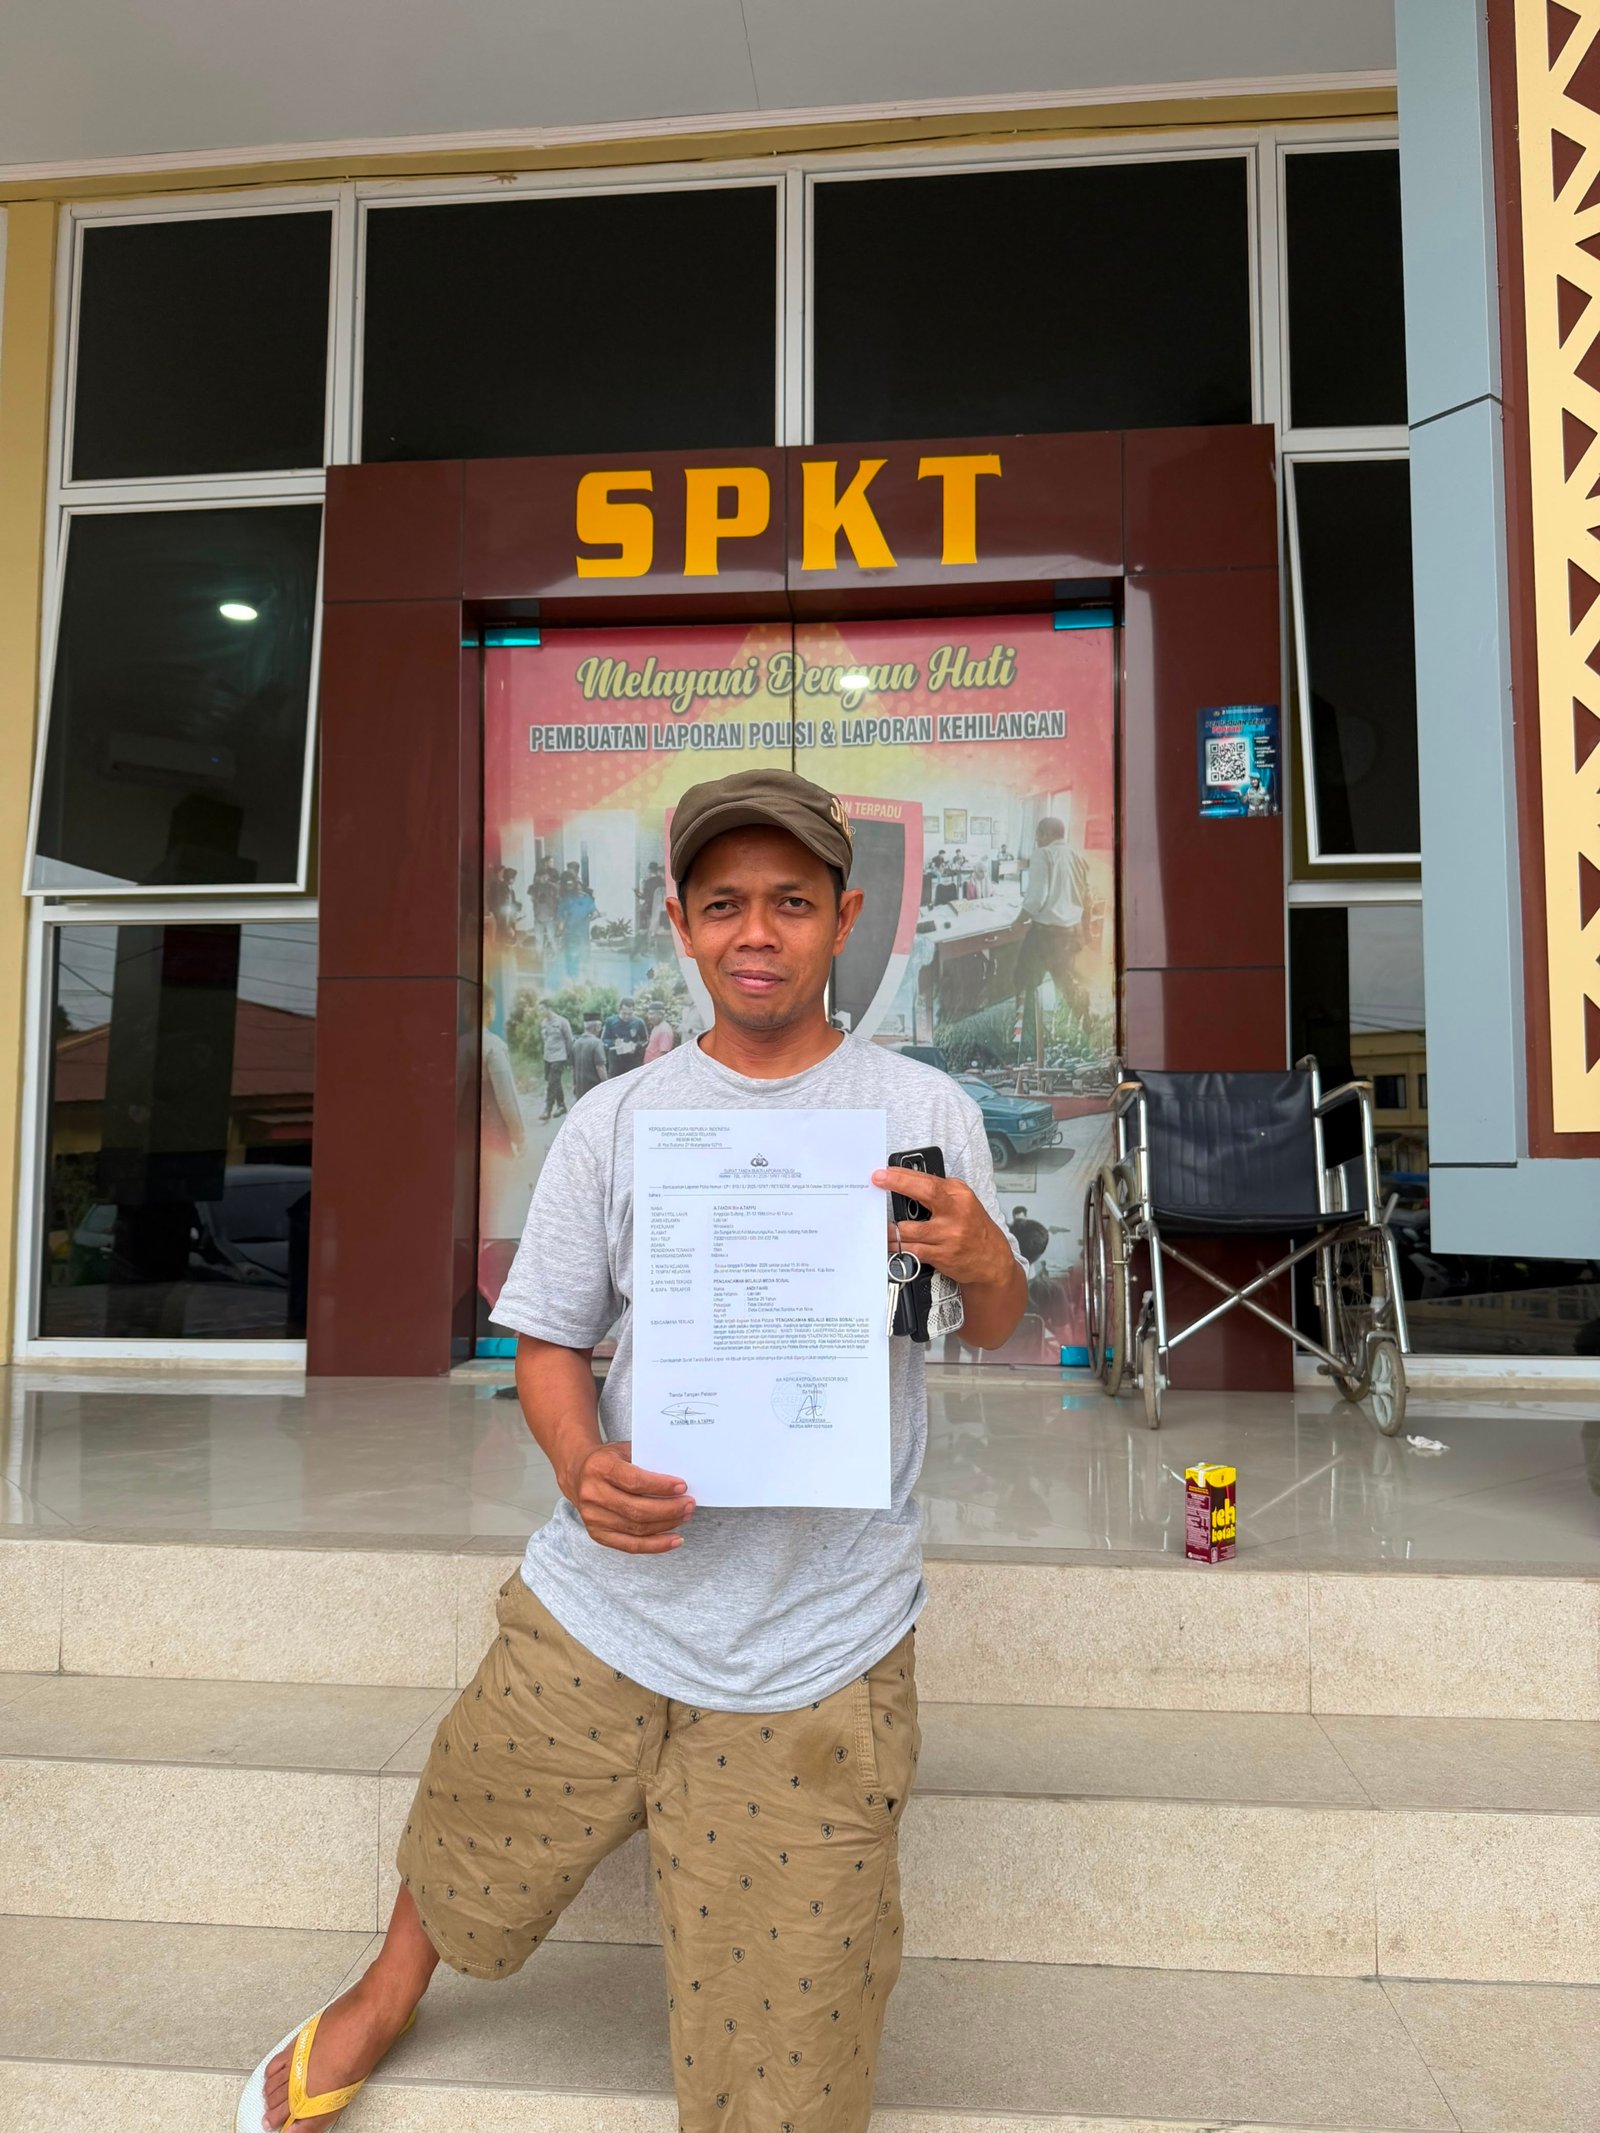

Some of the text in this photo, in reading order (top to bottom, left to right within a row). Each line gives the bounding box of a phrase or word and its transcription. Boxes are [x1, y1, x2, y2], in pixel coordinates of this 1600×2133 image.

[576, 454, 1002, 578] SPKT
[575, 645, 1018, 715] Melayani Dengan Hati
[529, 710, 1066, 752] PEMBUATAN LAPORAN POLISI & LAPORAN KEHILANGAN
[854, 801, 903, 819] TERPADU
[1211, 1498, 1236, 1528] teh
